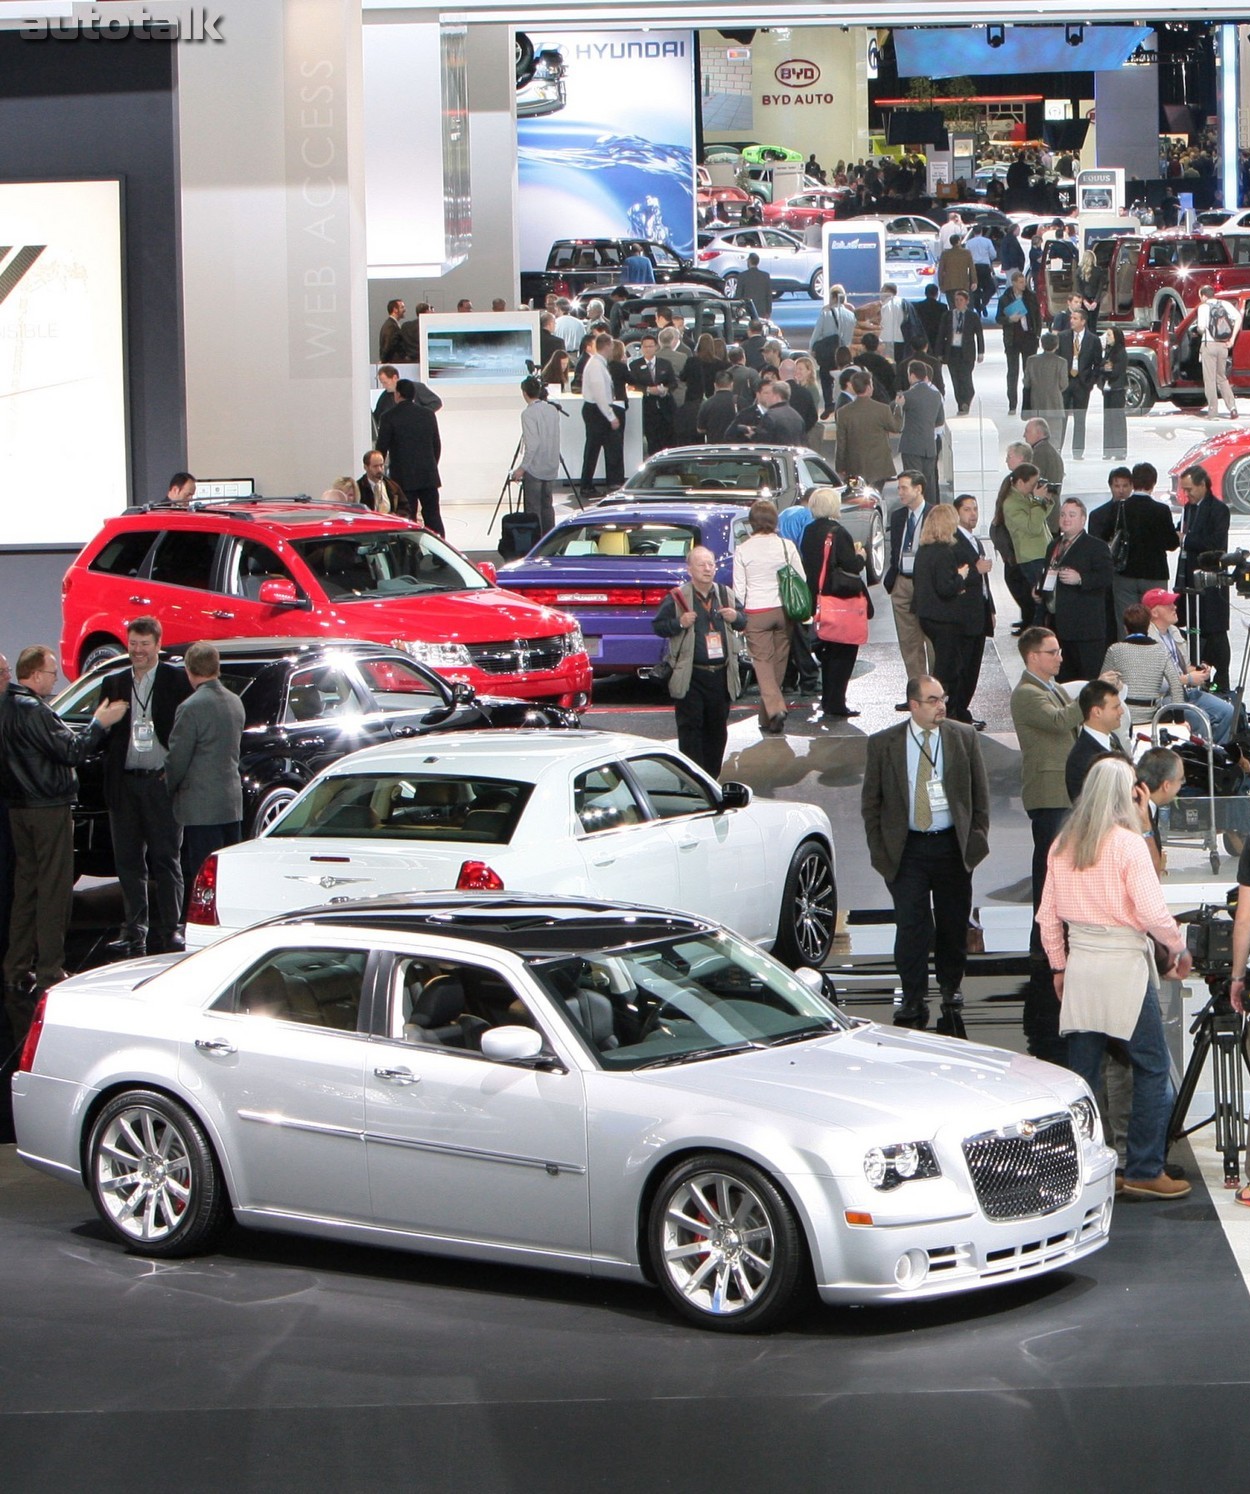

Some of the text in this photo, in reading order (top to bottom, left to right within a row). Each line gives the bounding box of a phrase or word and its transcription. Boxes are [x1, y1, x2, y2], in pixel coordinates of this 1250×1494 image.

[575, 41, 685, 59] HYUNDAI
[780, 67, 815, 80] BYD
[762, 93, 834, 106] BYD AUTO
[1083, 174, 1111, 183] EQUUS
[299, 58, 337, 361] WEB ACCESS
